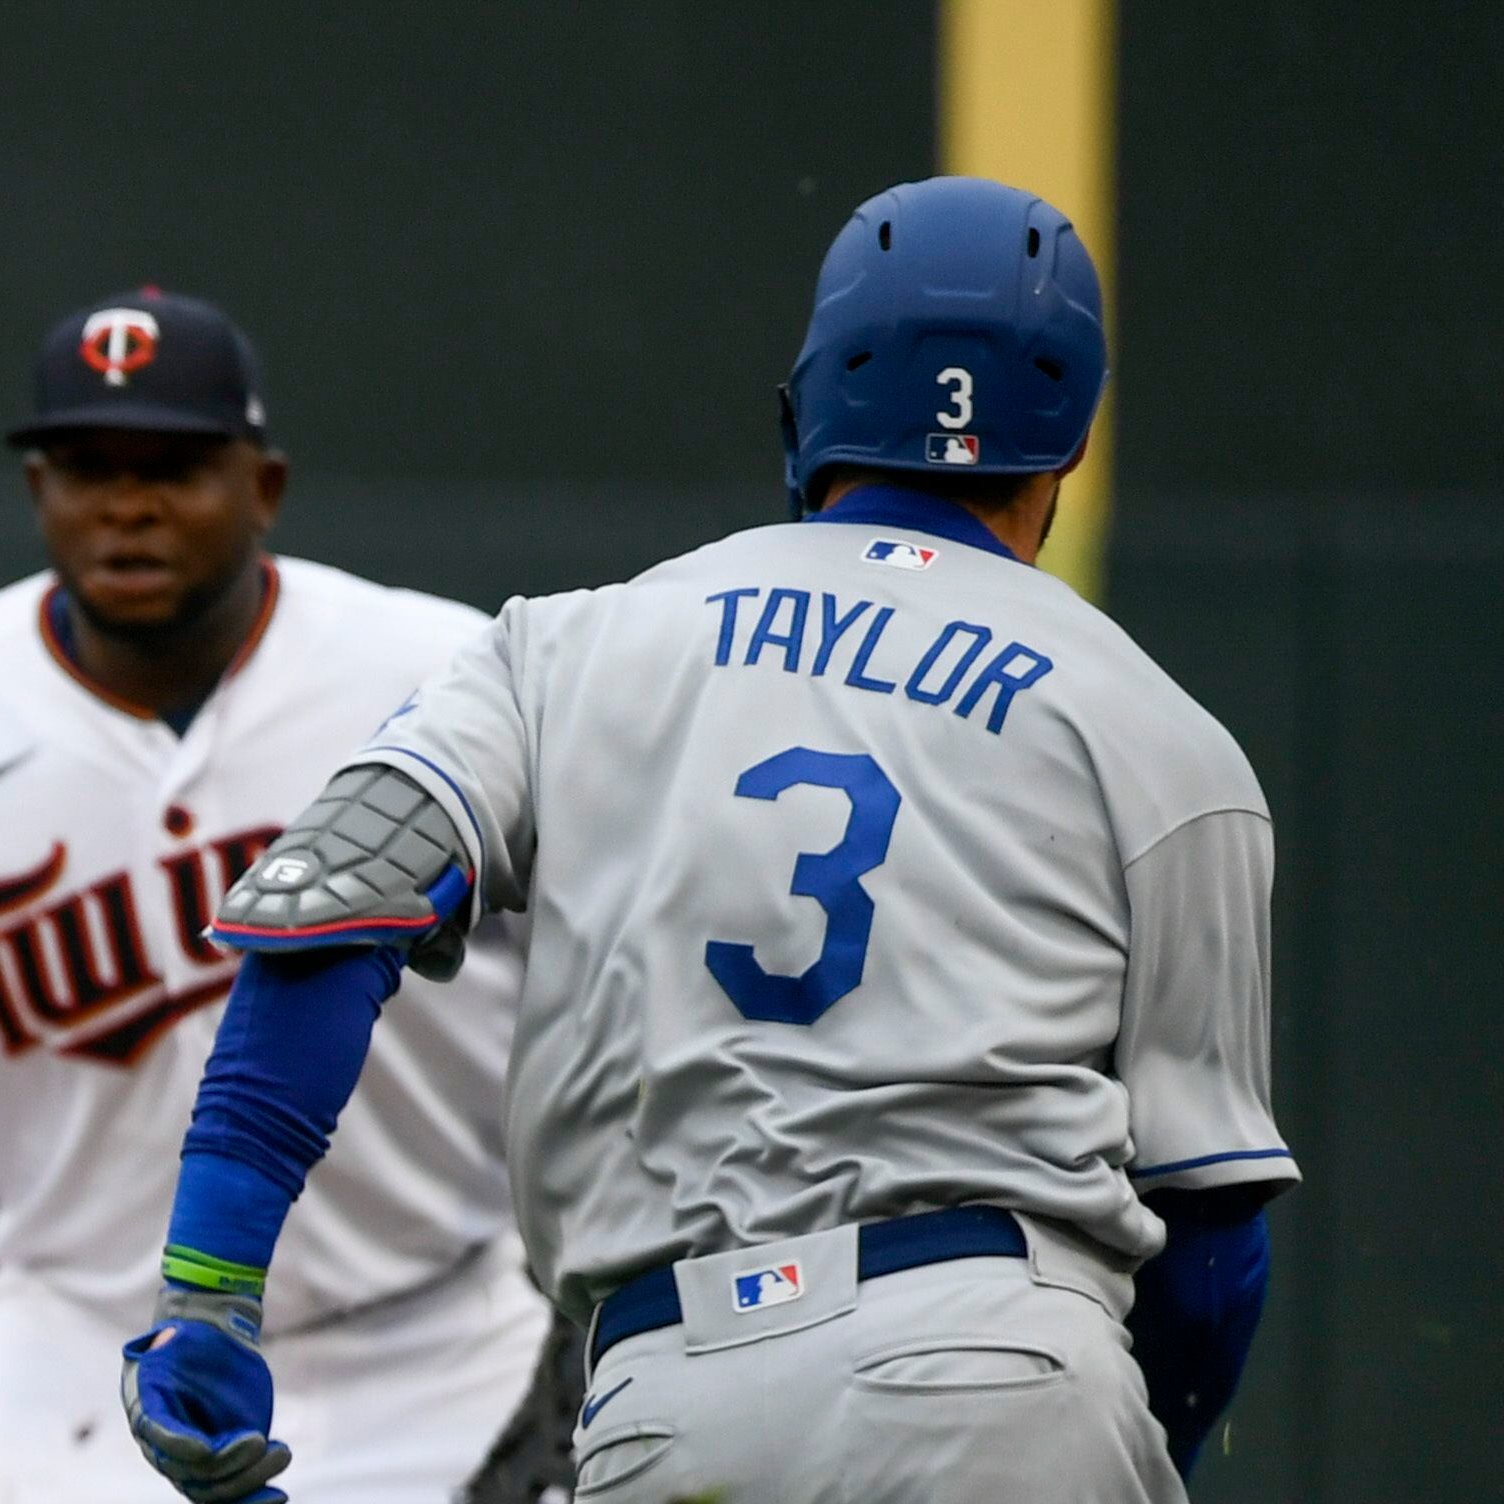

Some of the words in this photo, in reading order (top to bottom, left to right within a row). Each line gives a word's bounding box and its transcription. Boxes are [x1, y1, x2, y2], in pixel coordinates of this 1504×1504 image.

[936, 367, 973, 429] 3
[705, 587, 1054, 735] TAYLOR
[704, 746, 902, 1026] 3
